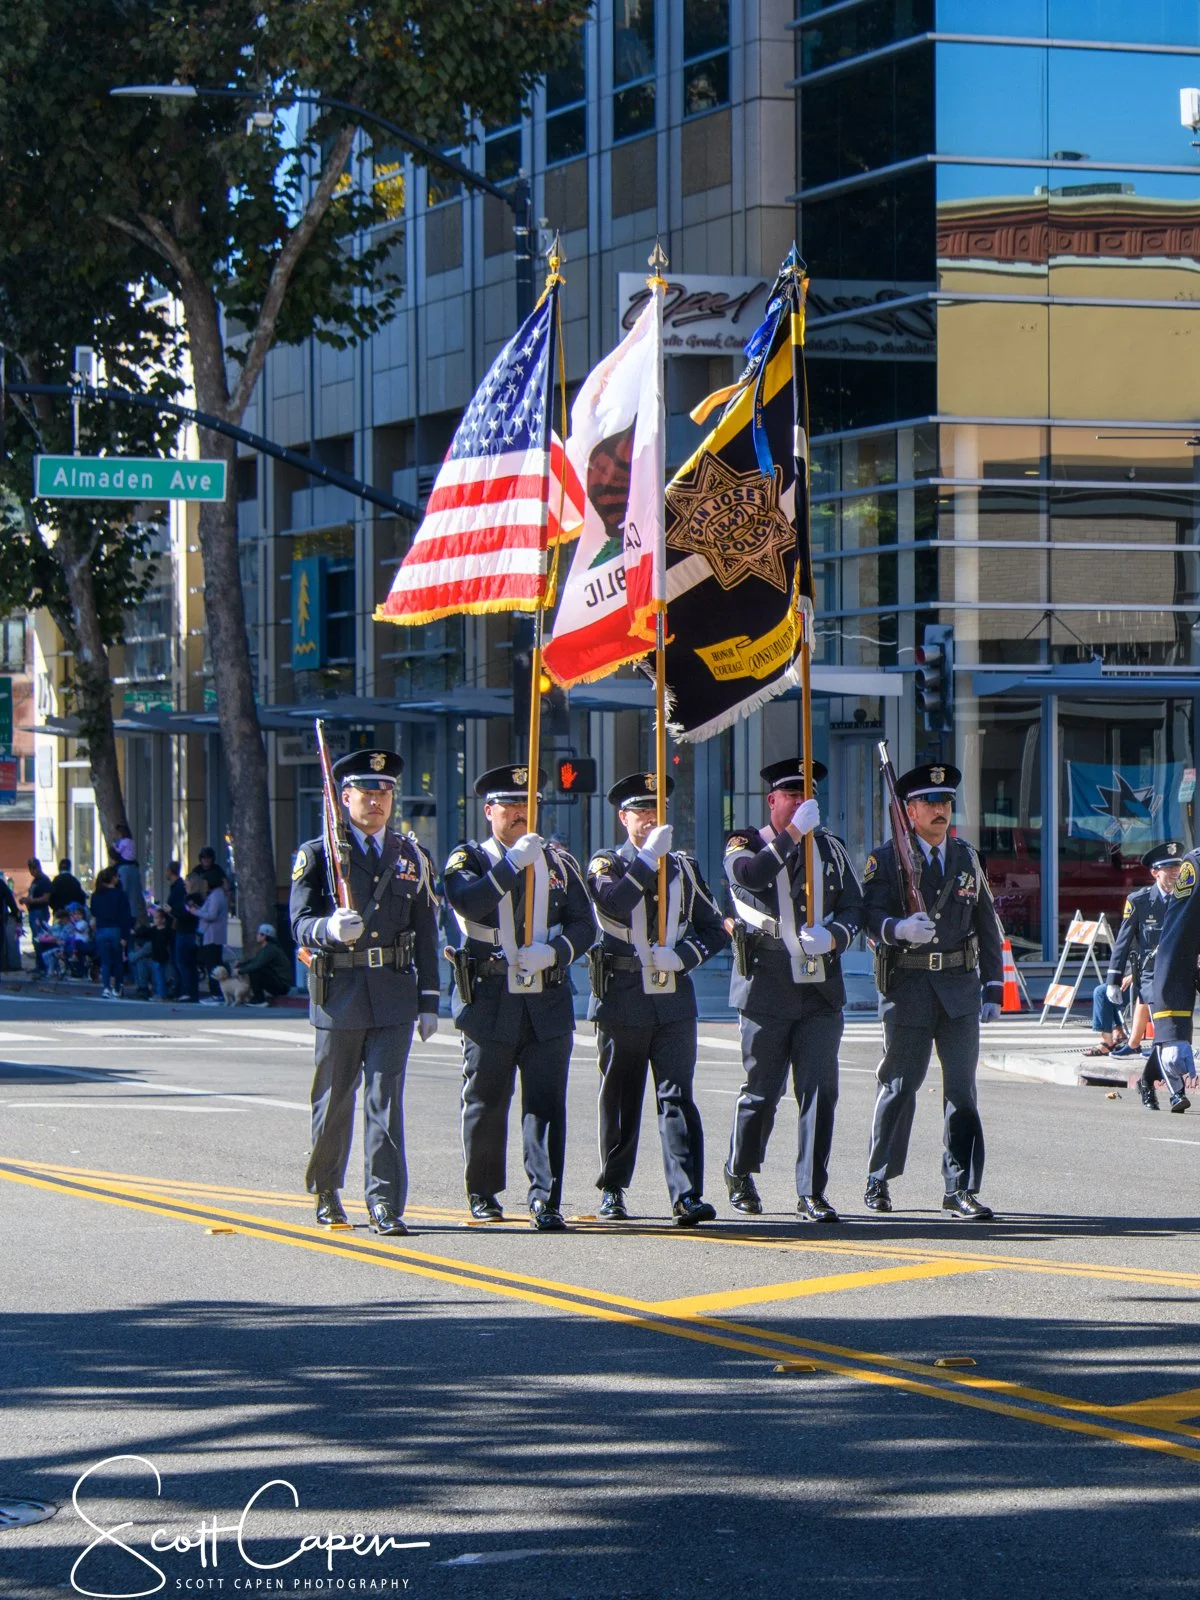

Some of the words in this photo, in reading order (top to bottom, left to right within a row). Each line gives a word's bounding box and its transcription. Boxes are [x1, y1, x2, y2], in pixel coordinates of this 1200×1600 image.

[53, 467, 153, 489] Almaden
[169, 470, 212, 491] Ave
[690, 507, 711, 537] SAN
[712, 488, 756, 511] JOSE
[713, 509, 746, 538] 1849
[720, 518, 773, 553] POLICE
[711, 647, 735, 662] HONOR
[713, 660, 744, 677] COURAGE
